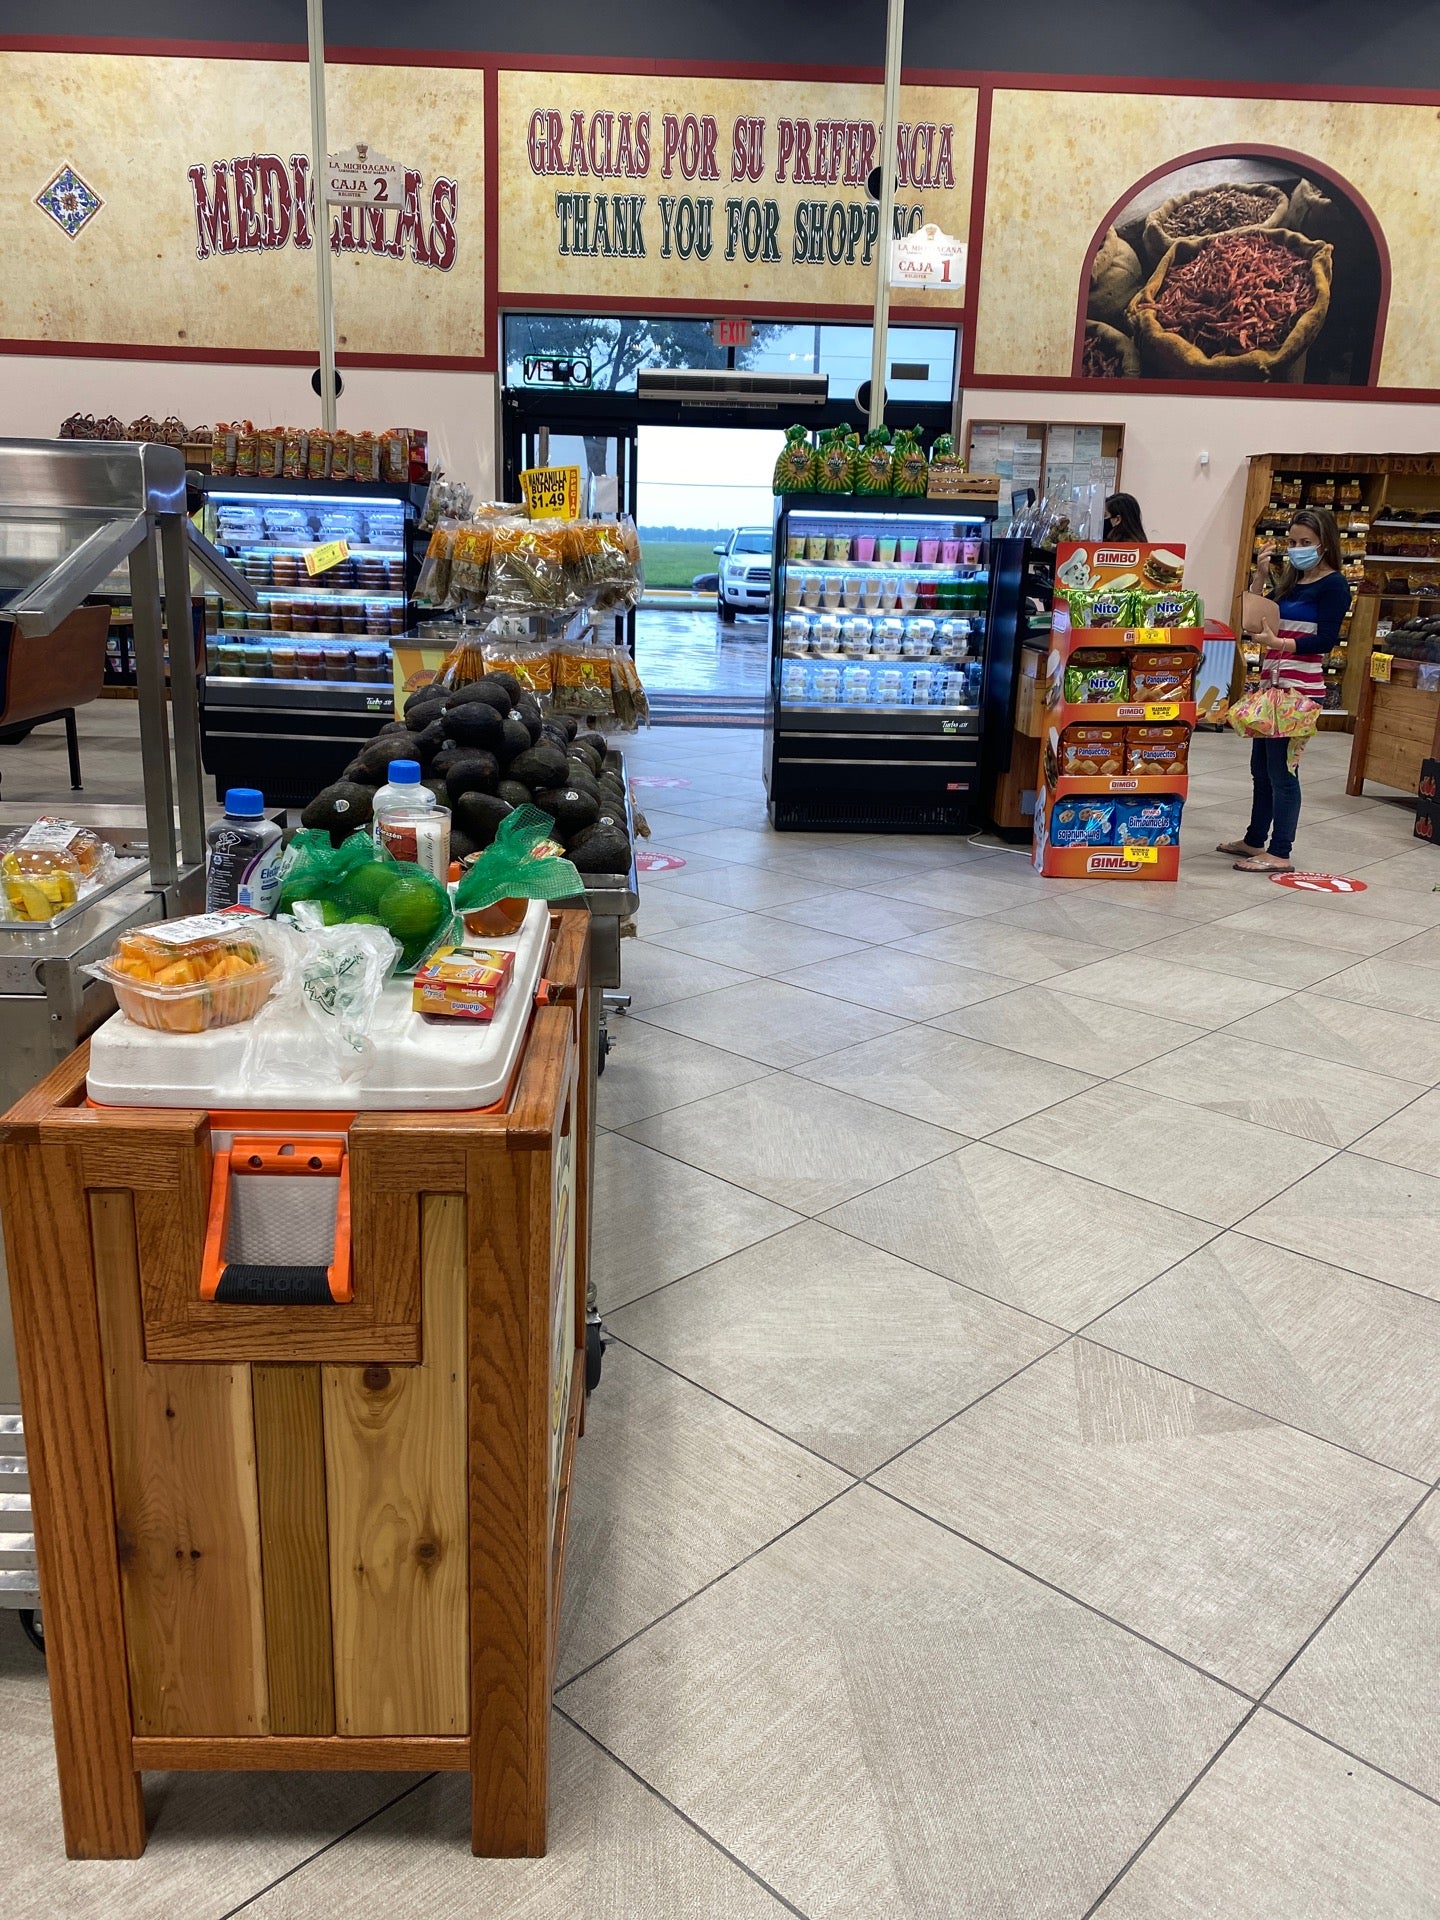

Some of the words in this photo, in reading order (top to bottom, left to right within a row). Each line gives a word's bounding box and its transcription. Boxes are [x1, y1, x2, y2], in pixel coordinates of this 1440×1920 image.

[527, 108, 651, 179] GRACIAS
[662, 112, 721, 181] POR
[731, 115, 766, 183] SU
[776, 117, 956, 190] PREFERNCIA
[329, 161, 340, 169] LA
[343, 163, 396, 172] MICHOACANA
[331, 178, 368, 190] CAJA
[373, 178, 389, 201] 2
[188, 153, 457, 271] MEDIINAS
[556, 190, 647, 258] THANK
[658, 195, 714, 261] YOU
[724, 197, 782, 263] FOR
[793, 200, 924, 266] SHOPPN
[898, 260, 934, 272] CAJA
[941, 260, 952, 283] 1
[720, 320, 747, 344] EXIT
[528, 470, 567, 487] MANZANILLA
[532, 483, 565, 494] BUNCH
[569, 471, 577, 516] SPECIAL
[532, 493, 565, 510] $1.49
[1096, 553, 1137, 563] BIMBO
[1094, 604, 1118, 613] Nito
[1156, 602, 1182, 612] Nito
[1090, 679, 1115, 688] Nito
[1143, 750, 1176, 760] Panquecitos
[1091, 857, 1139, 868] BIMBO
[261, 866, 282, 879] Electr
[477, 989, 488, 998] 18
[453, 1001, 480, 1012] diamond
